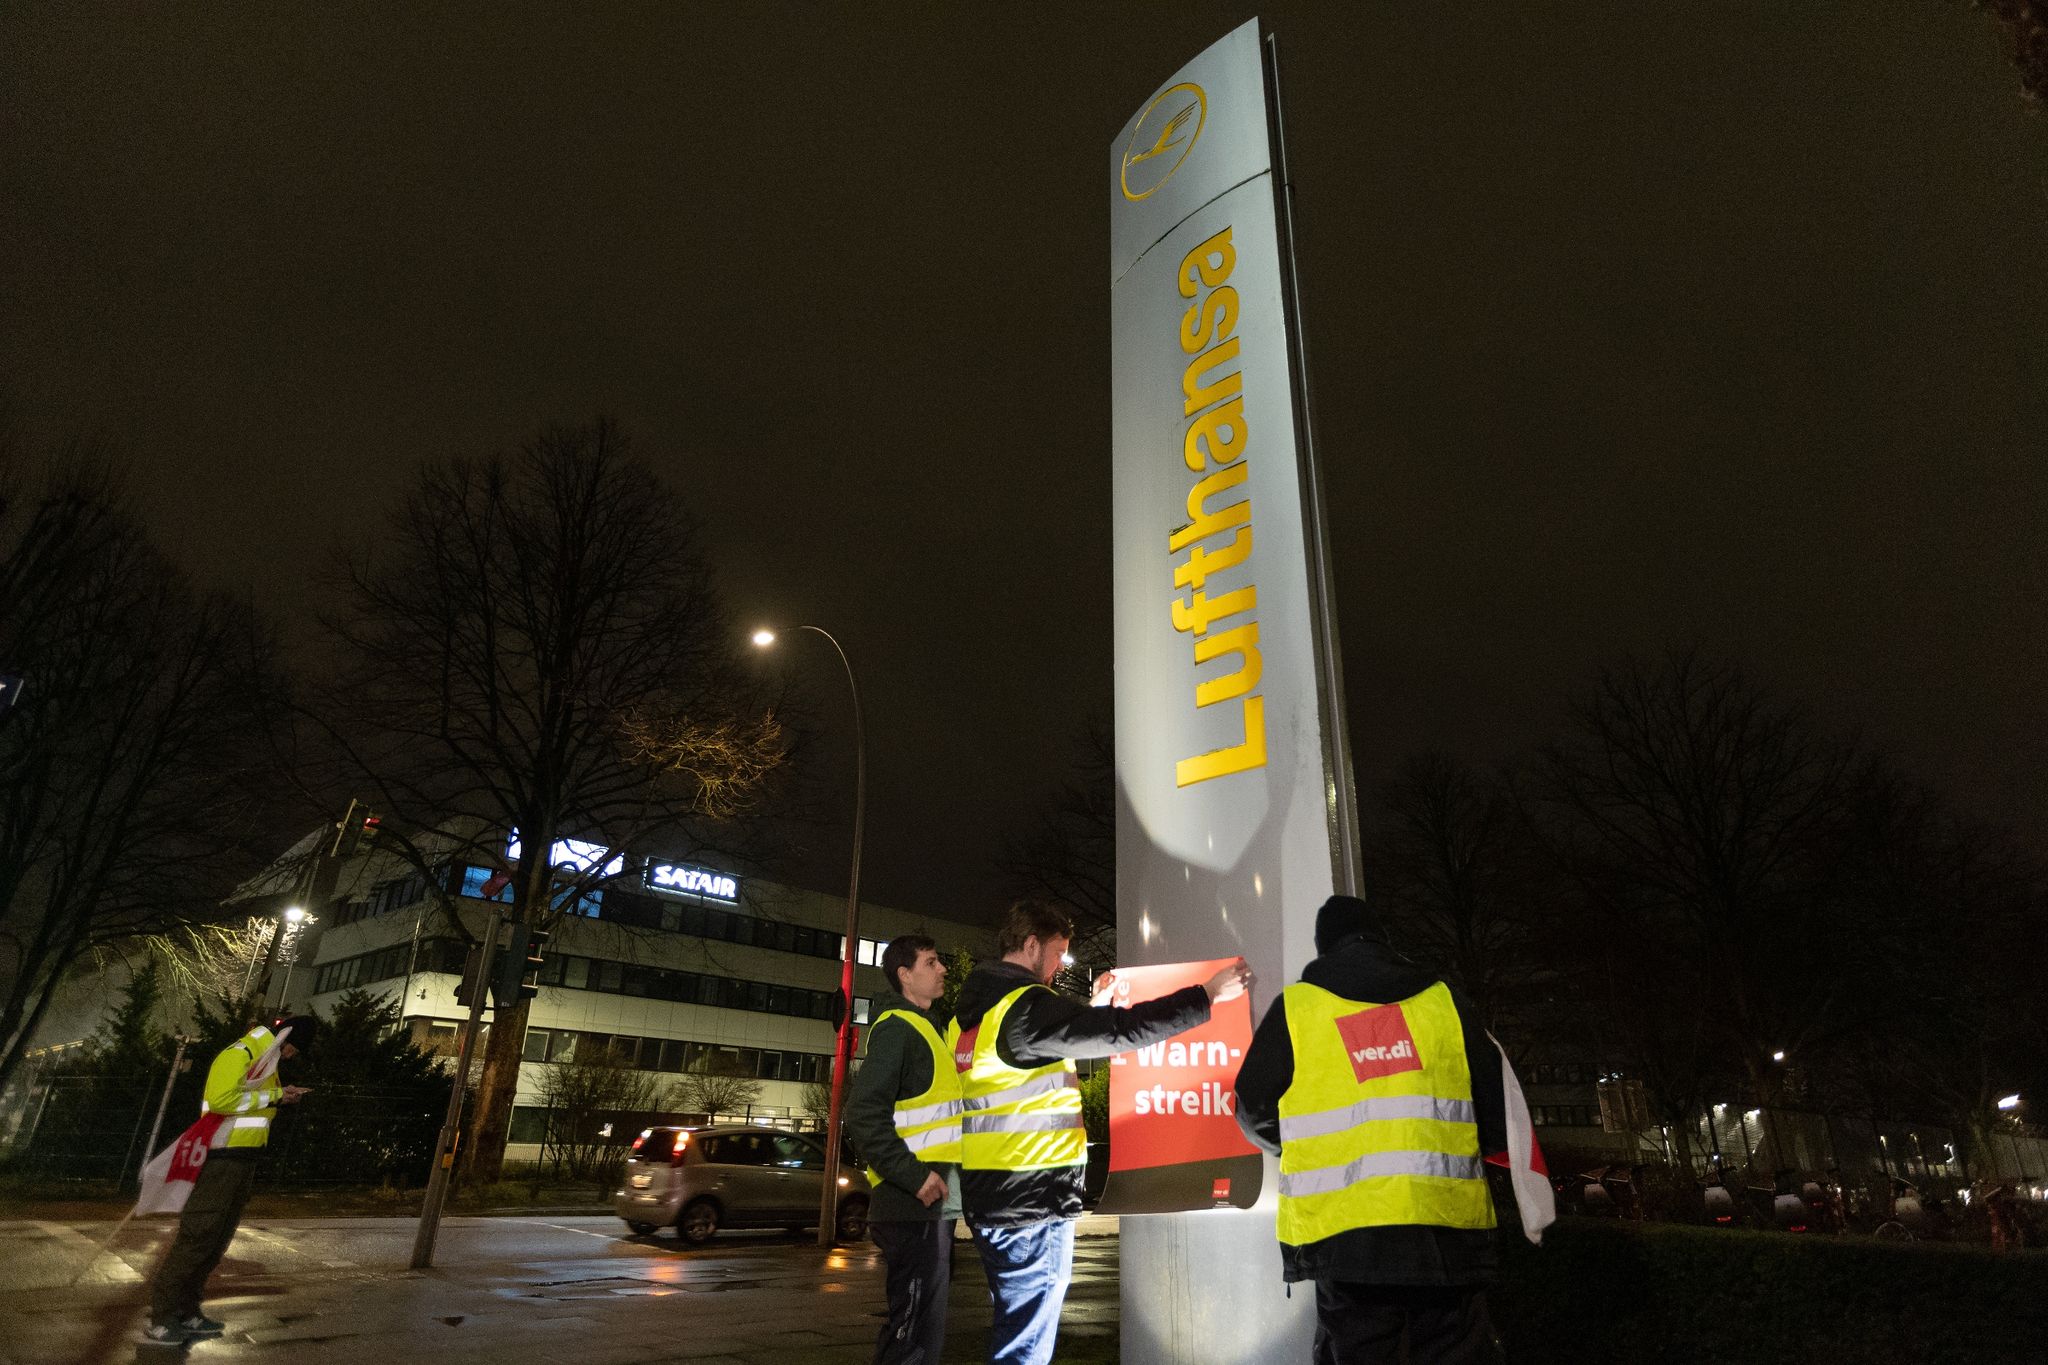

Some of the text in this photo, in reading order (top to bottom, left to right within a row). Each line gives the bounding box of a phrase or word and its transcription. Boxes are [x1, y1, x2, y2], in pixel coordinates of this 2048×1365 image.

[1169, 224, 1267, 788] Lufthansa
[654, 865, 736, 898] SATAIR
[1136, 1040, 1241, 1067] Warn-
[1352, 1040, 1413, 1064] ver.di
[1135, 1081, 1233, 1116] streik
